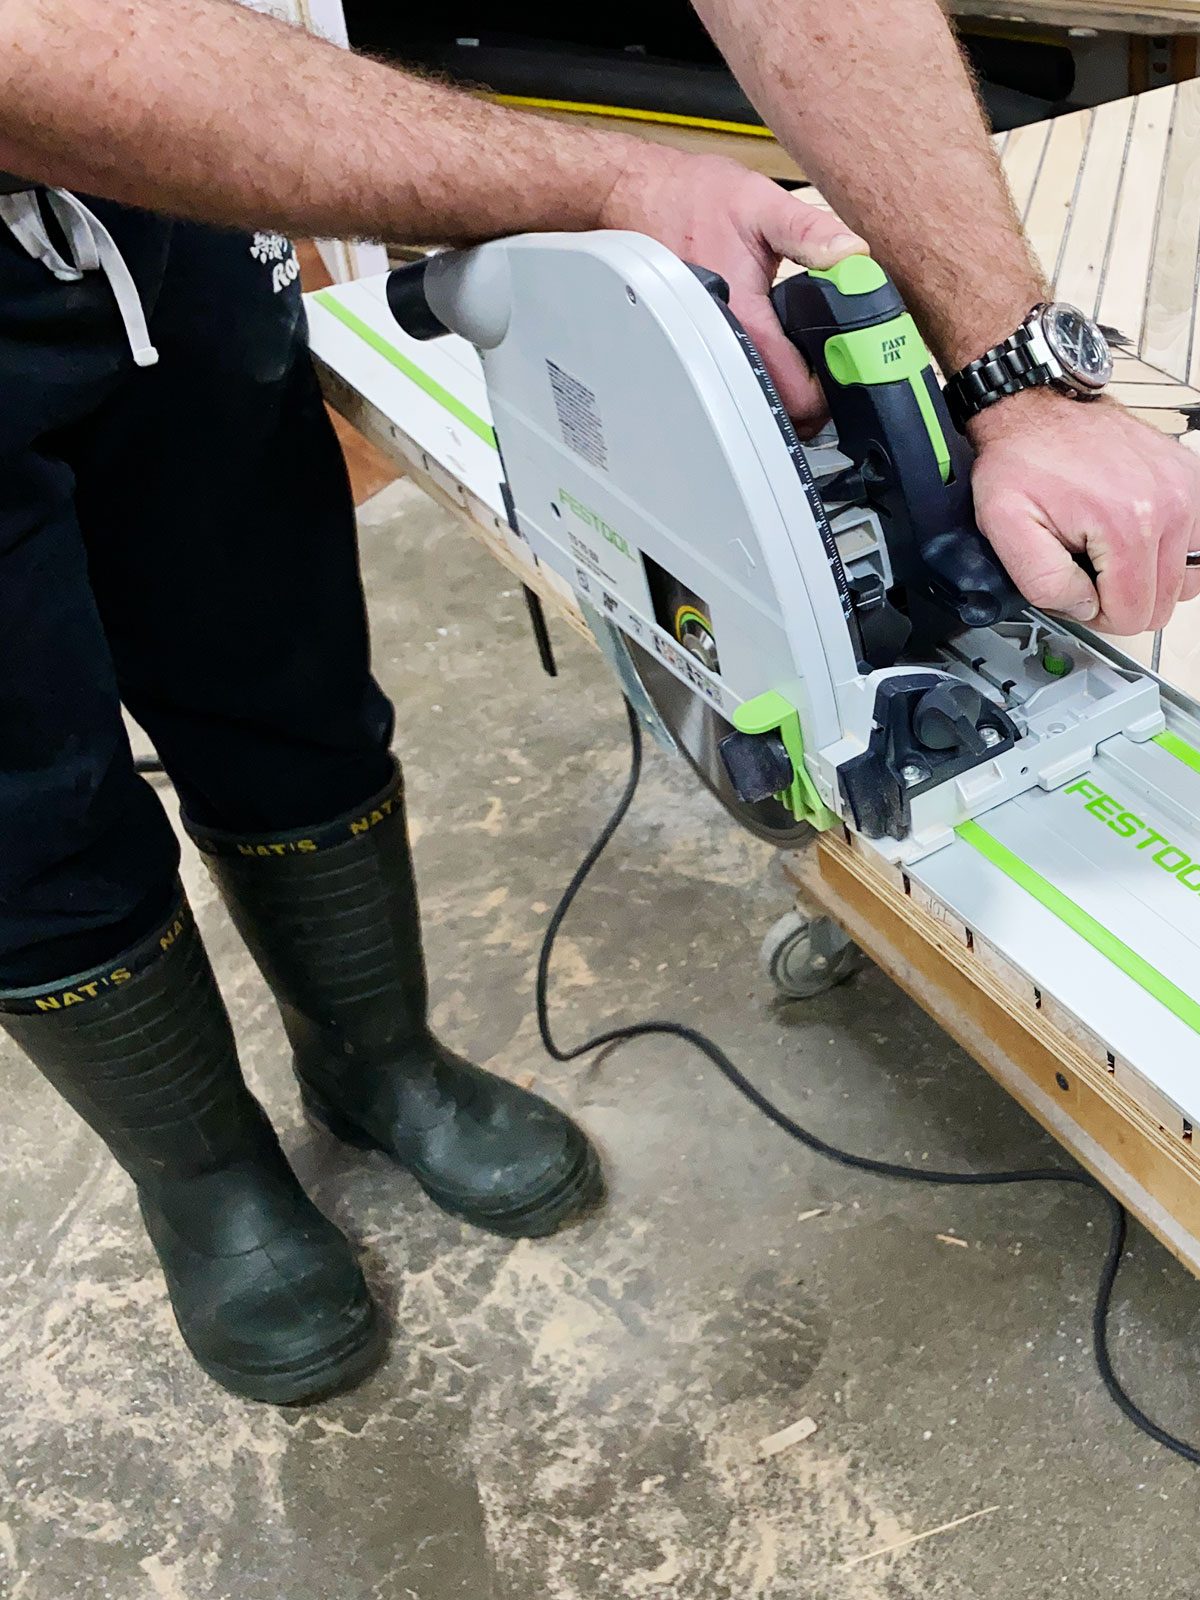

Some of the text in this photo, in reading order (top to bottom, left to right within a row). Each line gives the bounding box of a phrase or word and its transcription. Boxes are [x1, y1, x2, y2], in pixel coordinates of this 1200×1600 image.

[882, 335, 906, 352] FAST
[883, 349, 901, 364] FIX
[559, 487, 637, 563] FESTOOL
[236, 839, 318, 857] NAT'S
[35, 967, 132, 1011] NAT'S
